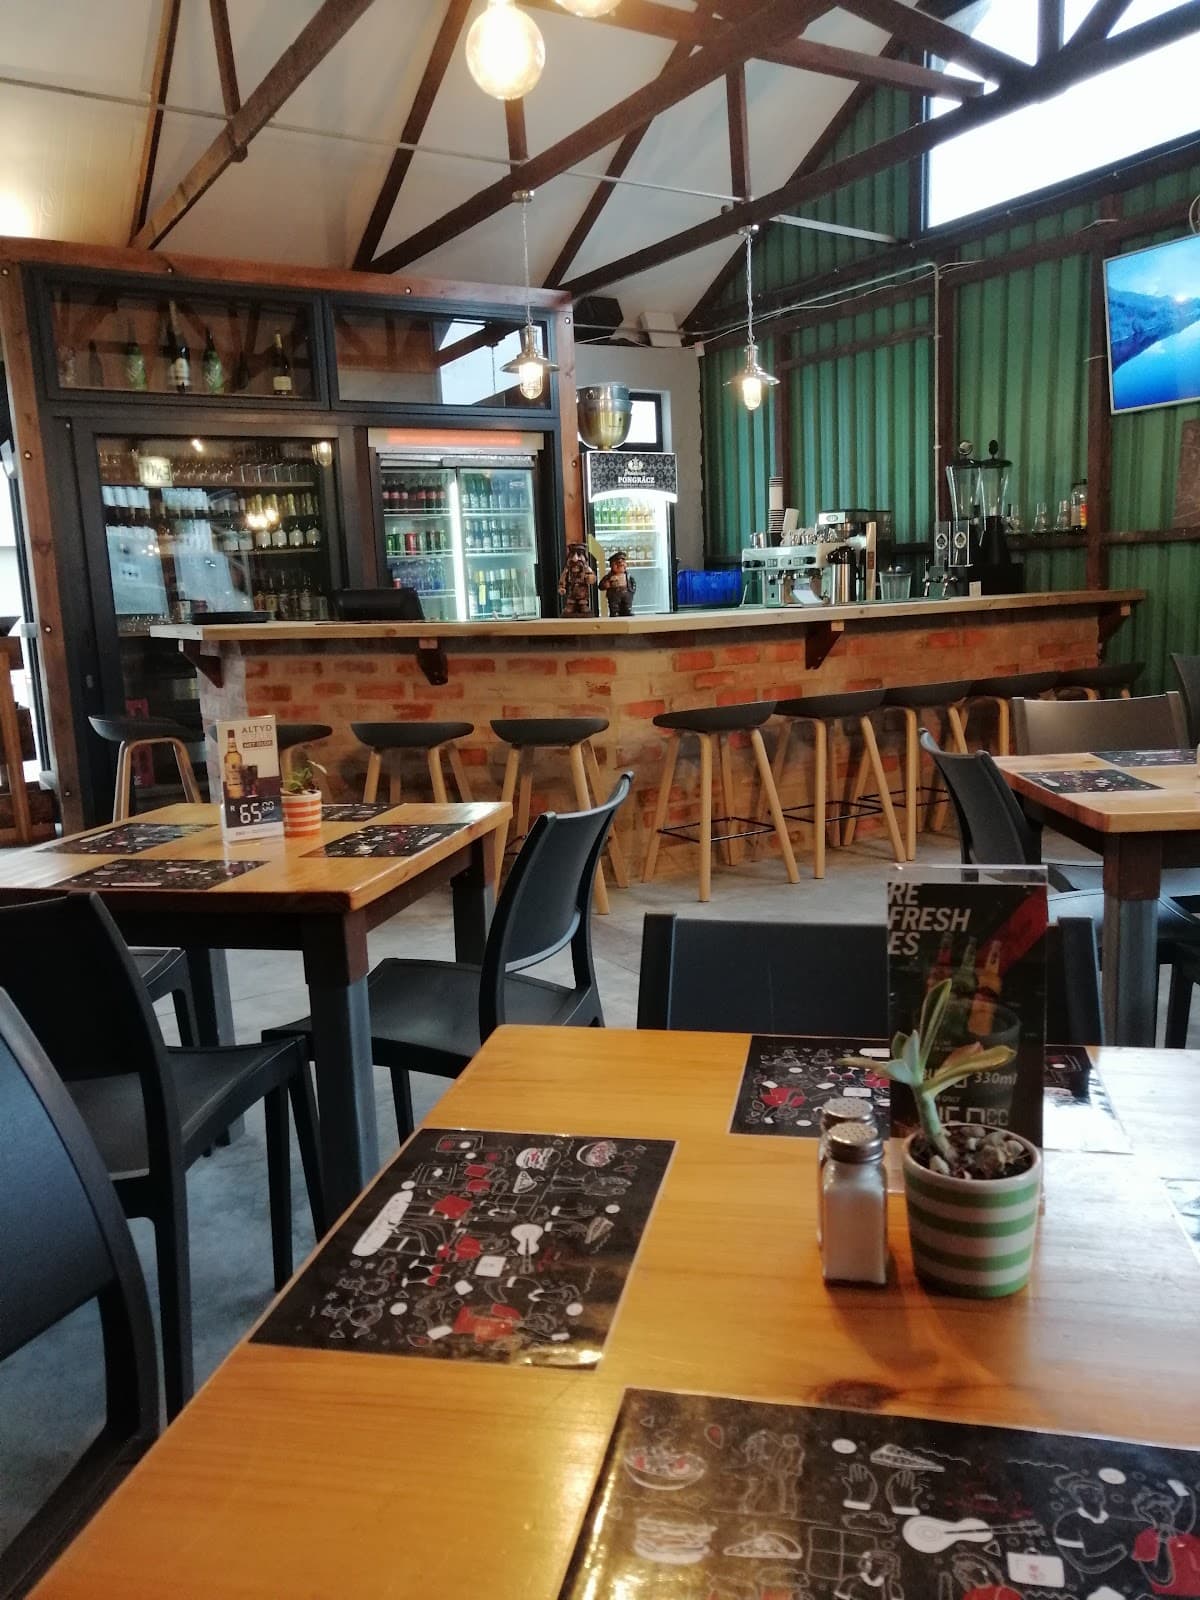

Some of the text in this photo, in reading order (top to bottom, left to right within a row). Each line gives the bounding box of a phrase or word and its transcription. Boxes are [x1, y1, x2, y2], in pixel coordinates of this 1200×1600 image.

[241, 725, 272, 734] ALTYD
[888, 882, 921, 905] RE
[888, 907, 971, 932] FRESH
[888, 932, 920, 955] ES
[974, 1072, 1018, 1085] 330ml
